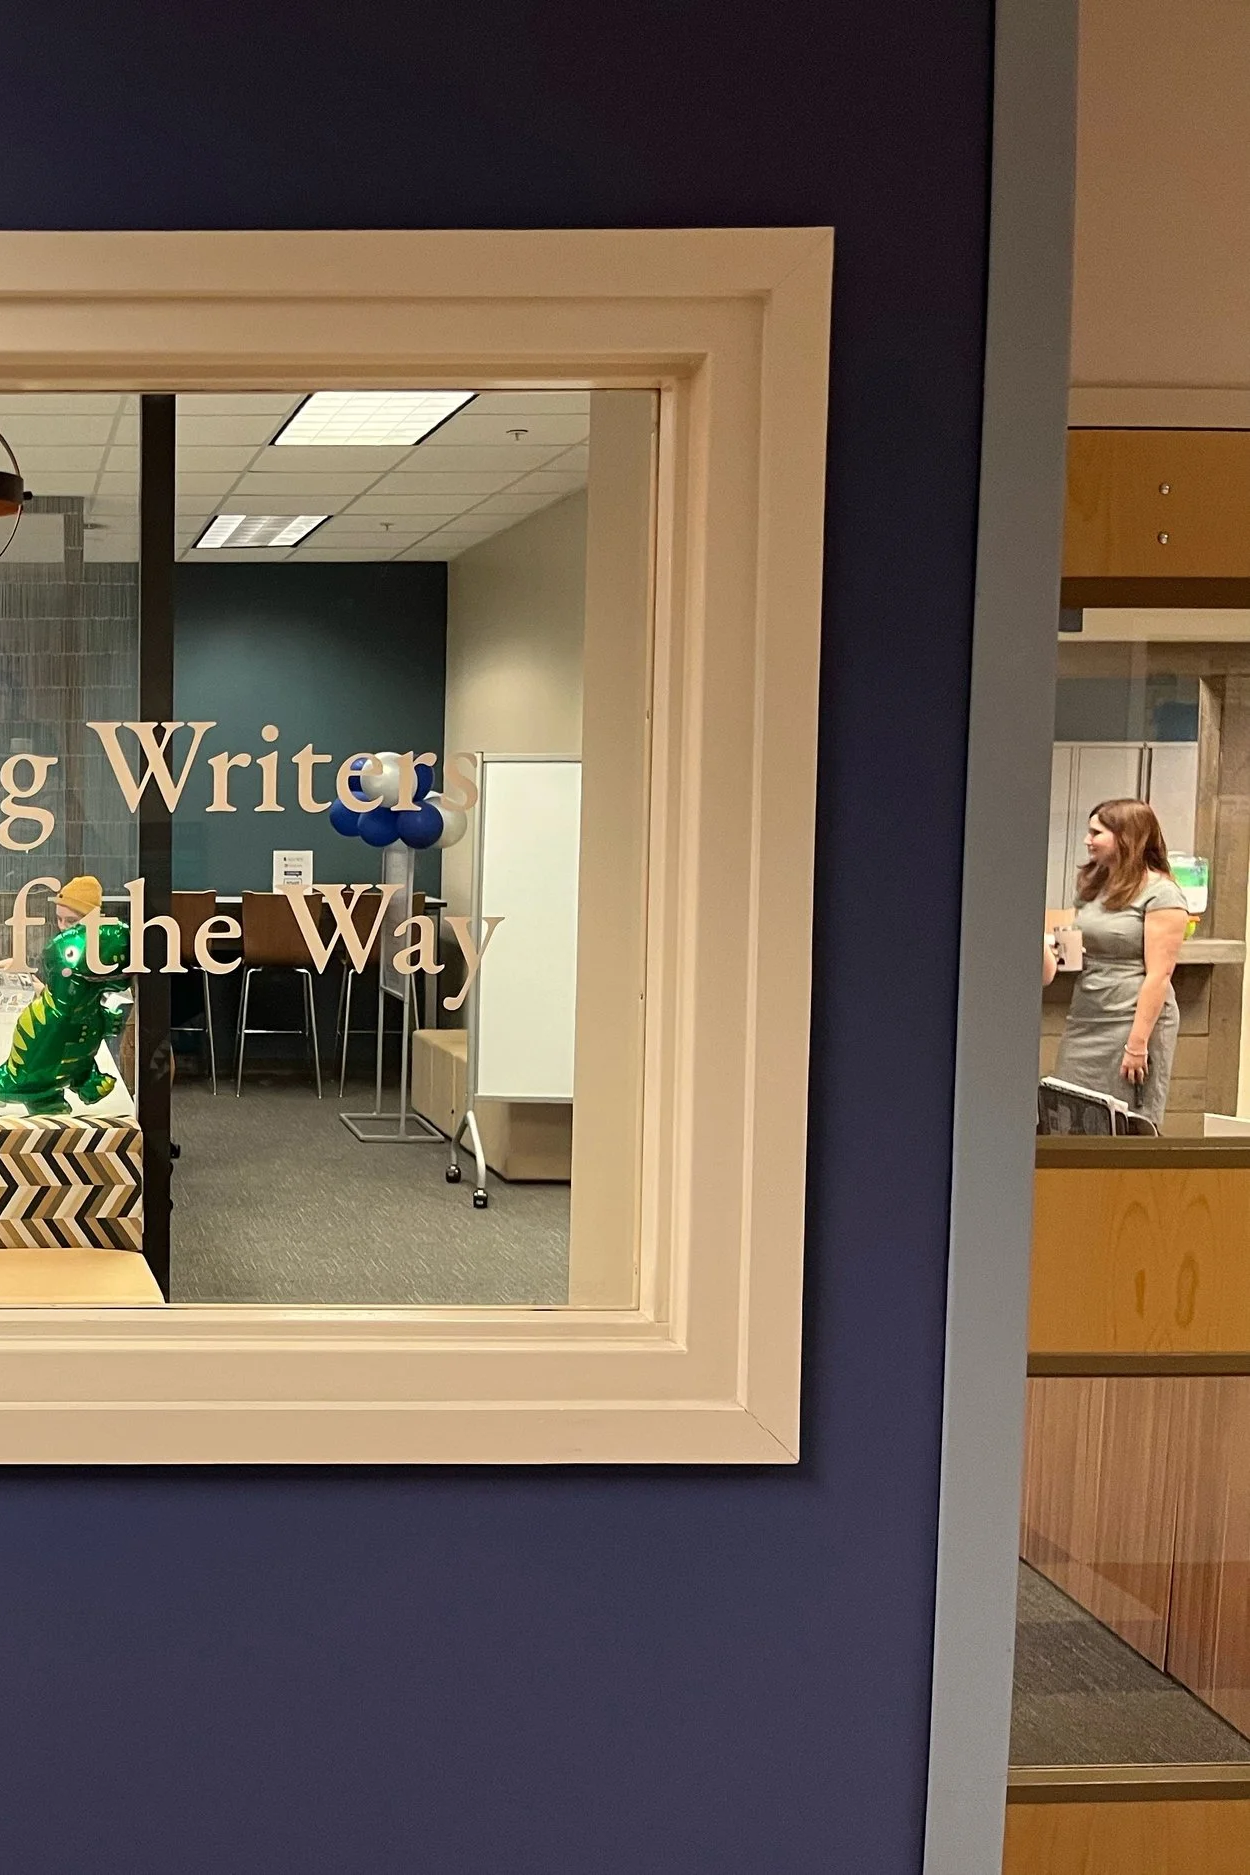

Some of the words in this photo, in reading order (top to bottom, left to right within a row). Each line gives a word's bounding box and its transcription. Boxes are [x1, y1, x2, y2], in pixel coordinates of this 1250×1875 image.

[85, 721, 479, 814] Writers
[85, 877, 243, 975] the
[275, 883, 506, 1011] Way
